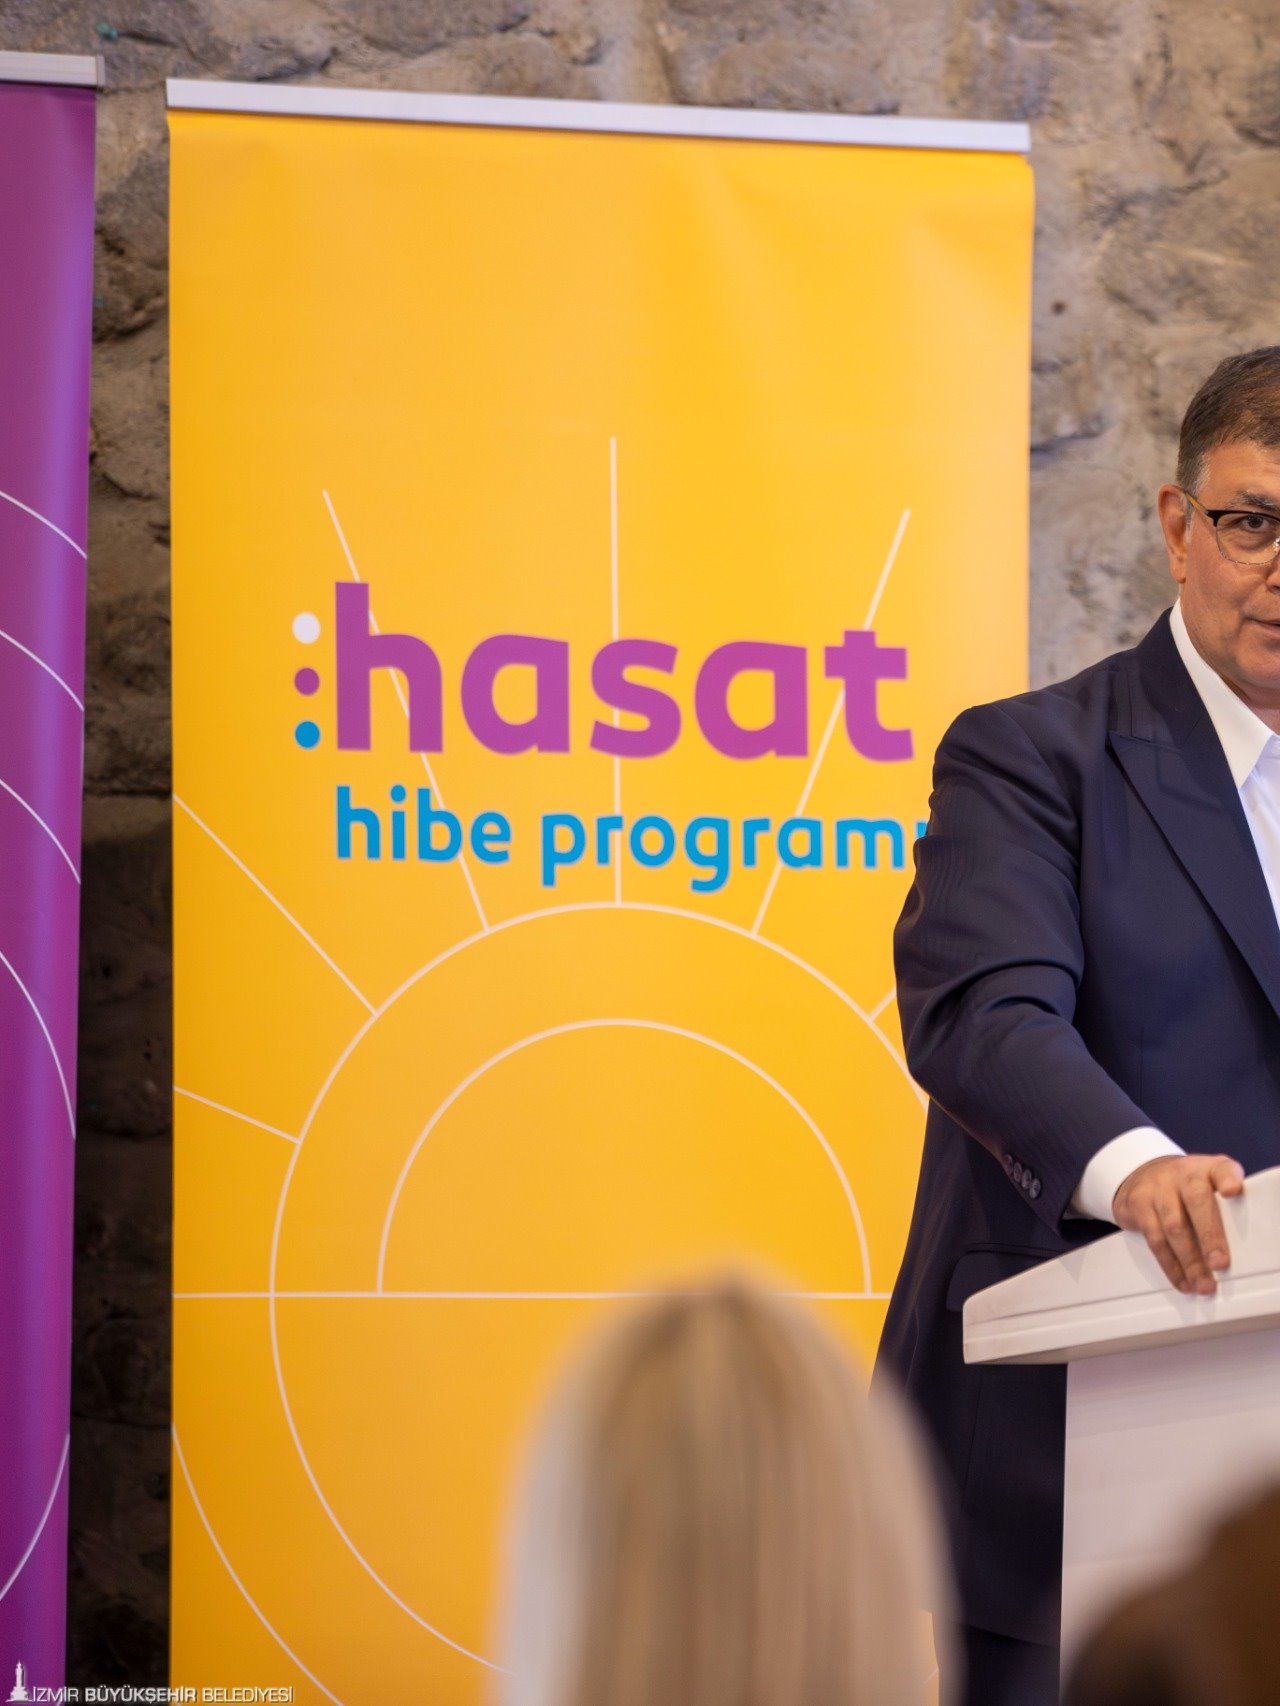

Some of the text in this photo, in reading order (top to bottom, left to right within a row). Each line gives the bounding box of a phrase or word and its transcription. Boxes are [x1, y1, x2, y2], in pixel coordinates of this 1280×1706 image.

[335, 581, 914, 763] hasat
[336, 784, 929, 894] hibe program
